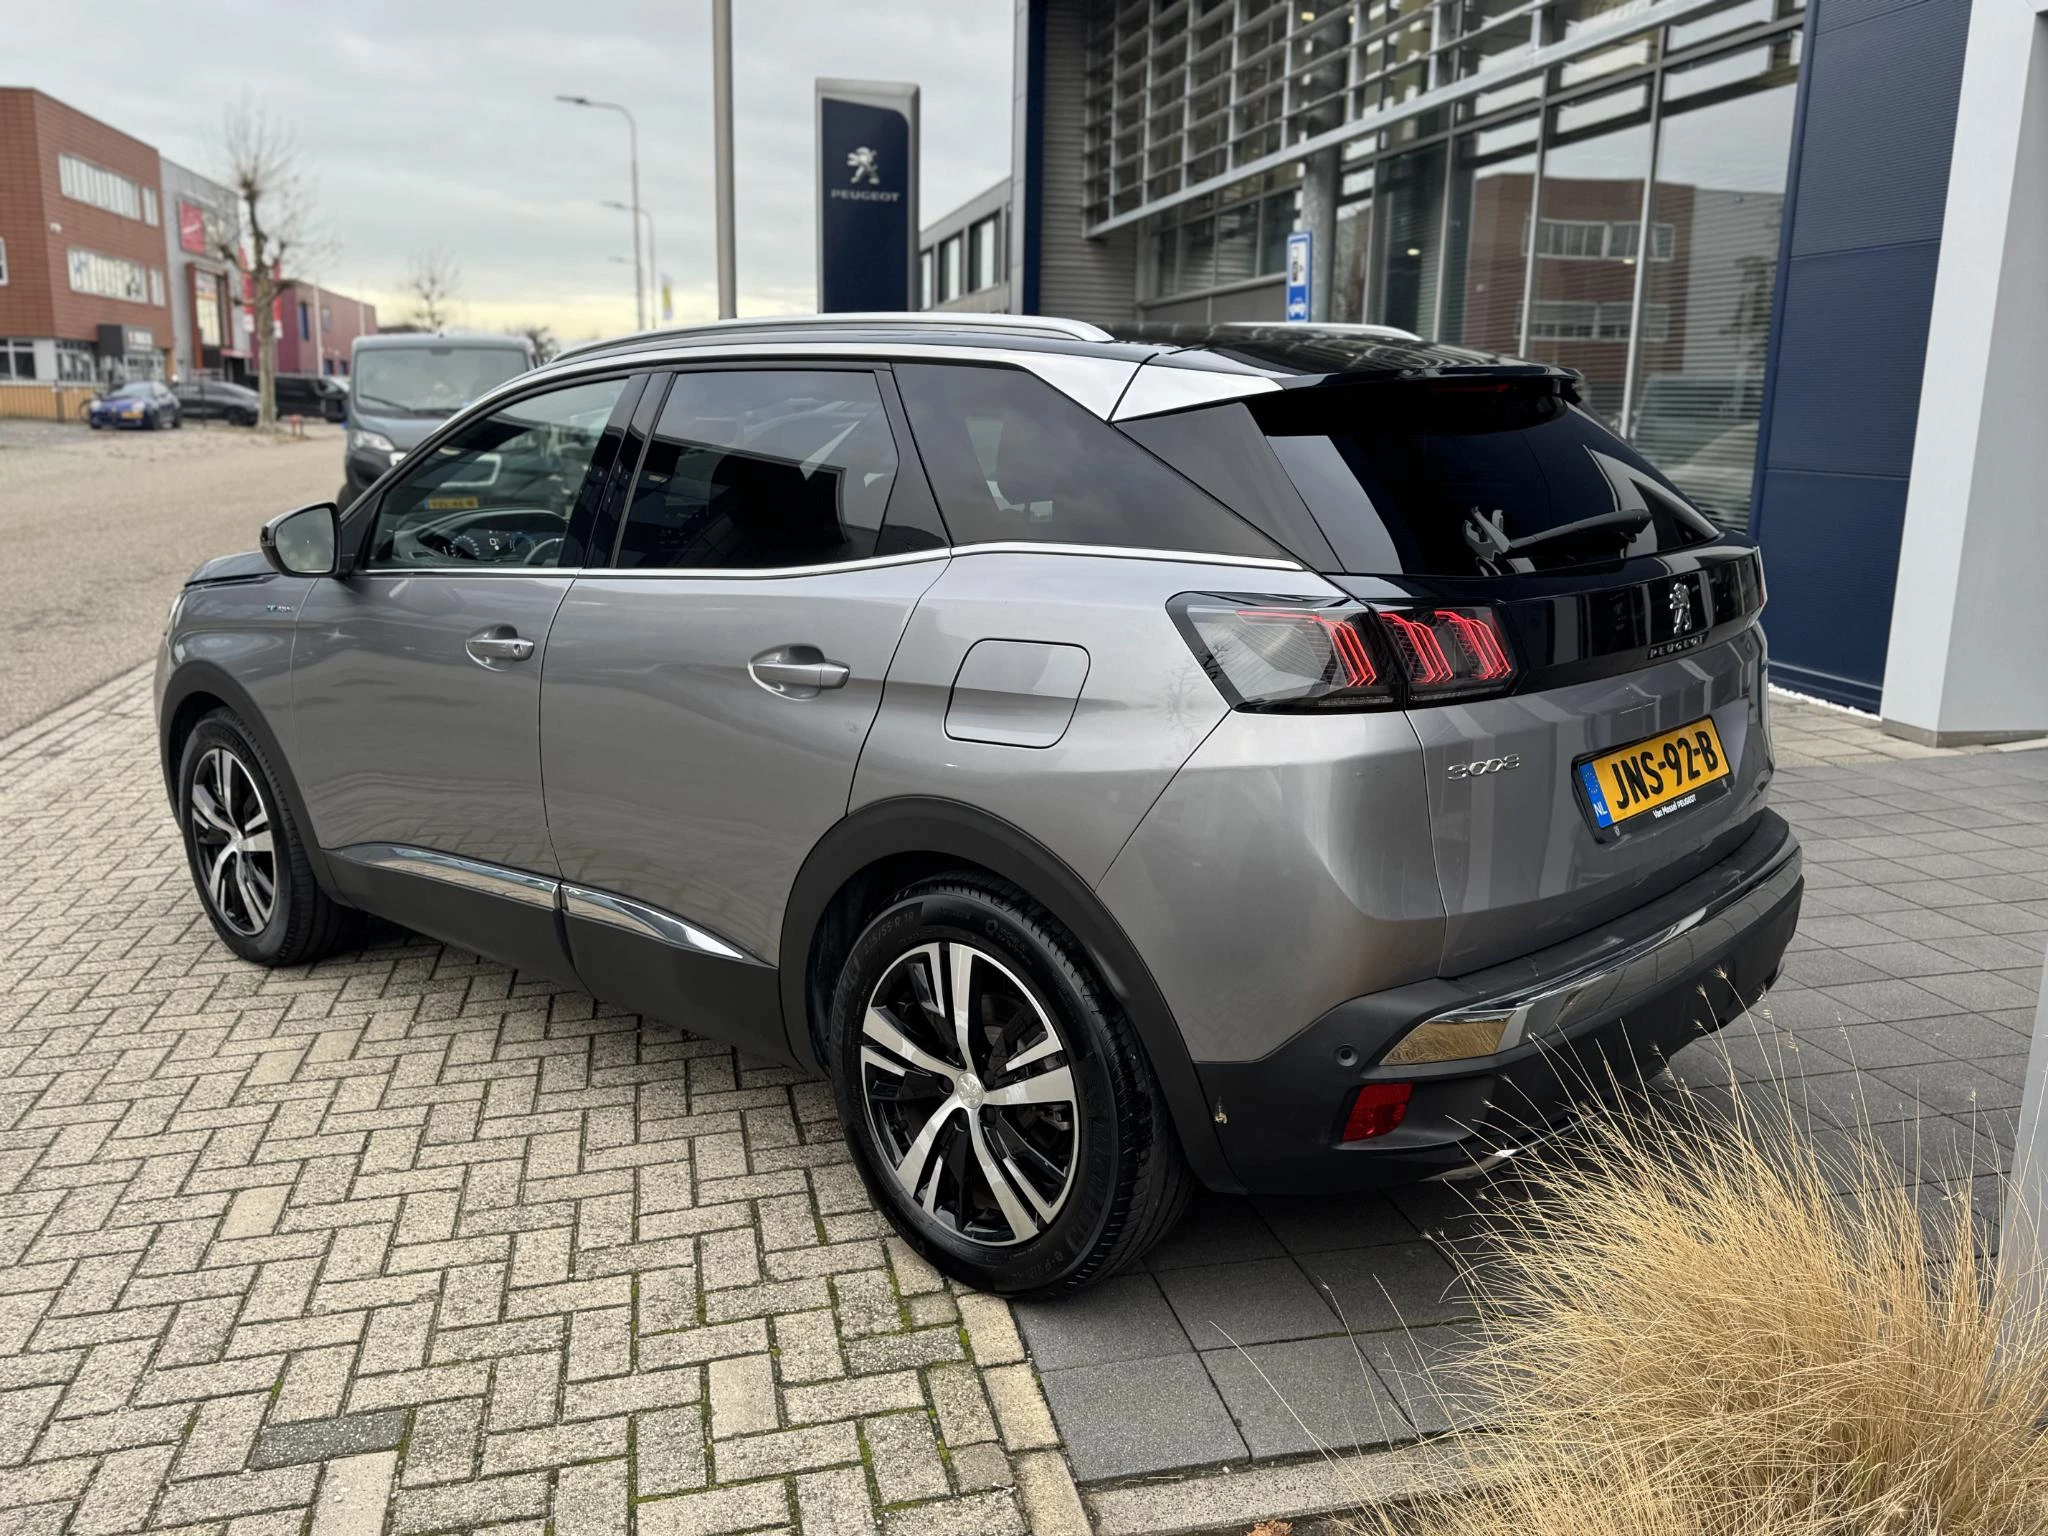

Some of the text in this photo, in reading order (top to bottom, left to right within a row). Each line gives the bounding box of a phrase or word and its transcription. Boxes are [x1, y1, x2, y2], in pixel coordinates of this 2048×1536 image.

[831, 188, 900, 203] PEUGEOT
[1649, 634, 1705, 659] PEUGEOT
[1447, 753, 1520, 781] 3008
[1611, 730, 1719, 810] JNS-92-B
[1593, 801, 1608, 818] NL
[1652, 809, 1664, 819] Van
[1677, 793, 1697, 808] PEUGEOT
